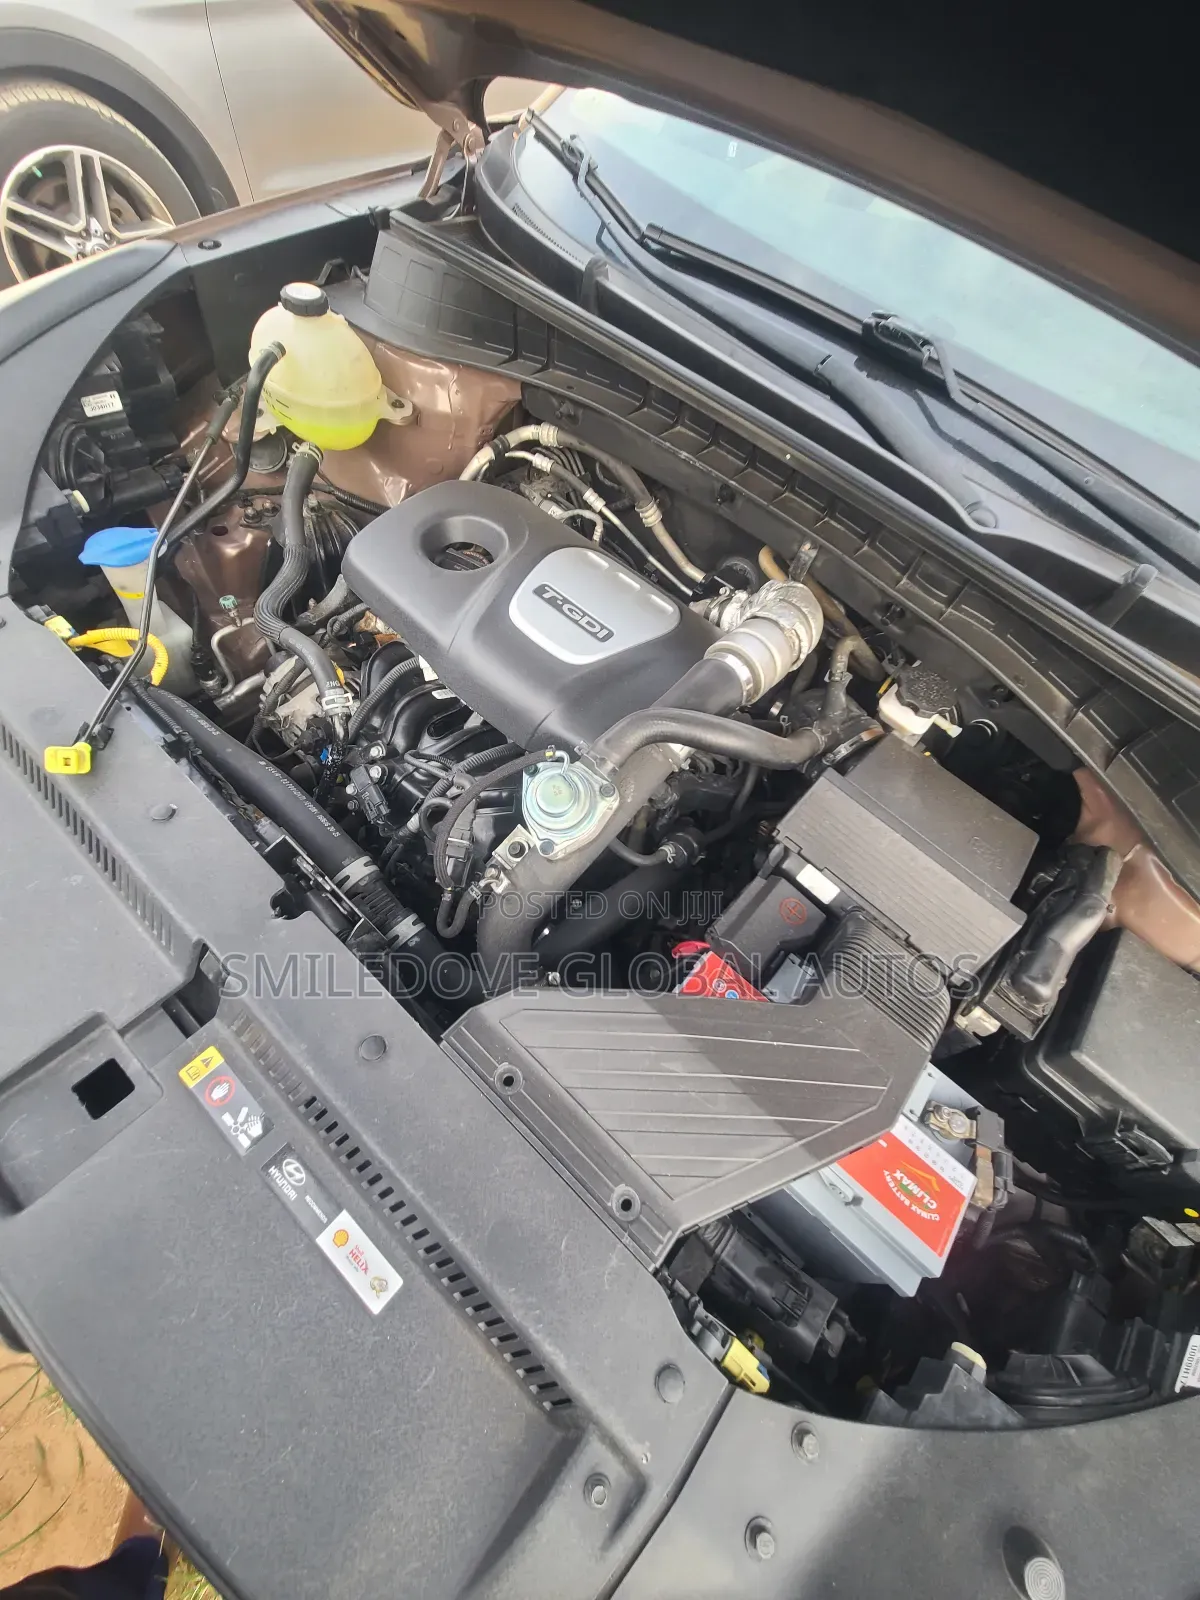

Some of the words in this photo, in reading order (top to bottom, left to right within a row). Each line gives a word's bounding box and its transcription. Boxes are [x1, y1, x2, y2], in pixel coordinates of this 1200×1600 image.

[268, 1165, 298, 1201] HYUNDAI
[883, 1169, 911, 1207] BATTERY
[893, 1168, 937, 1210] CLIMAX
[910, 1204, 940, 1221] CLIMAX
[349, 1249, 369, 1275] HELIX
